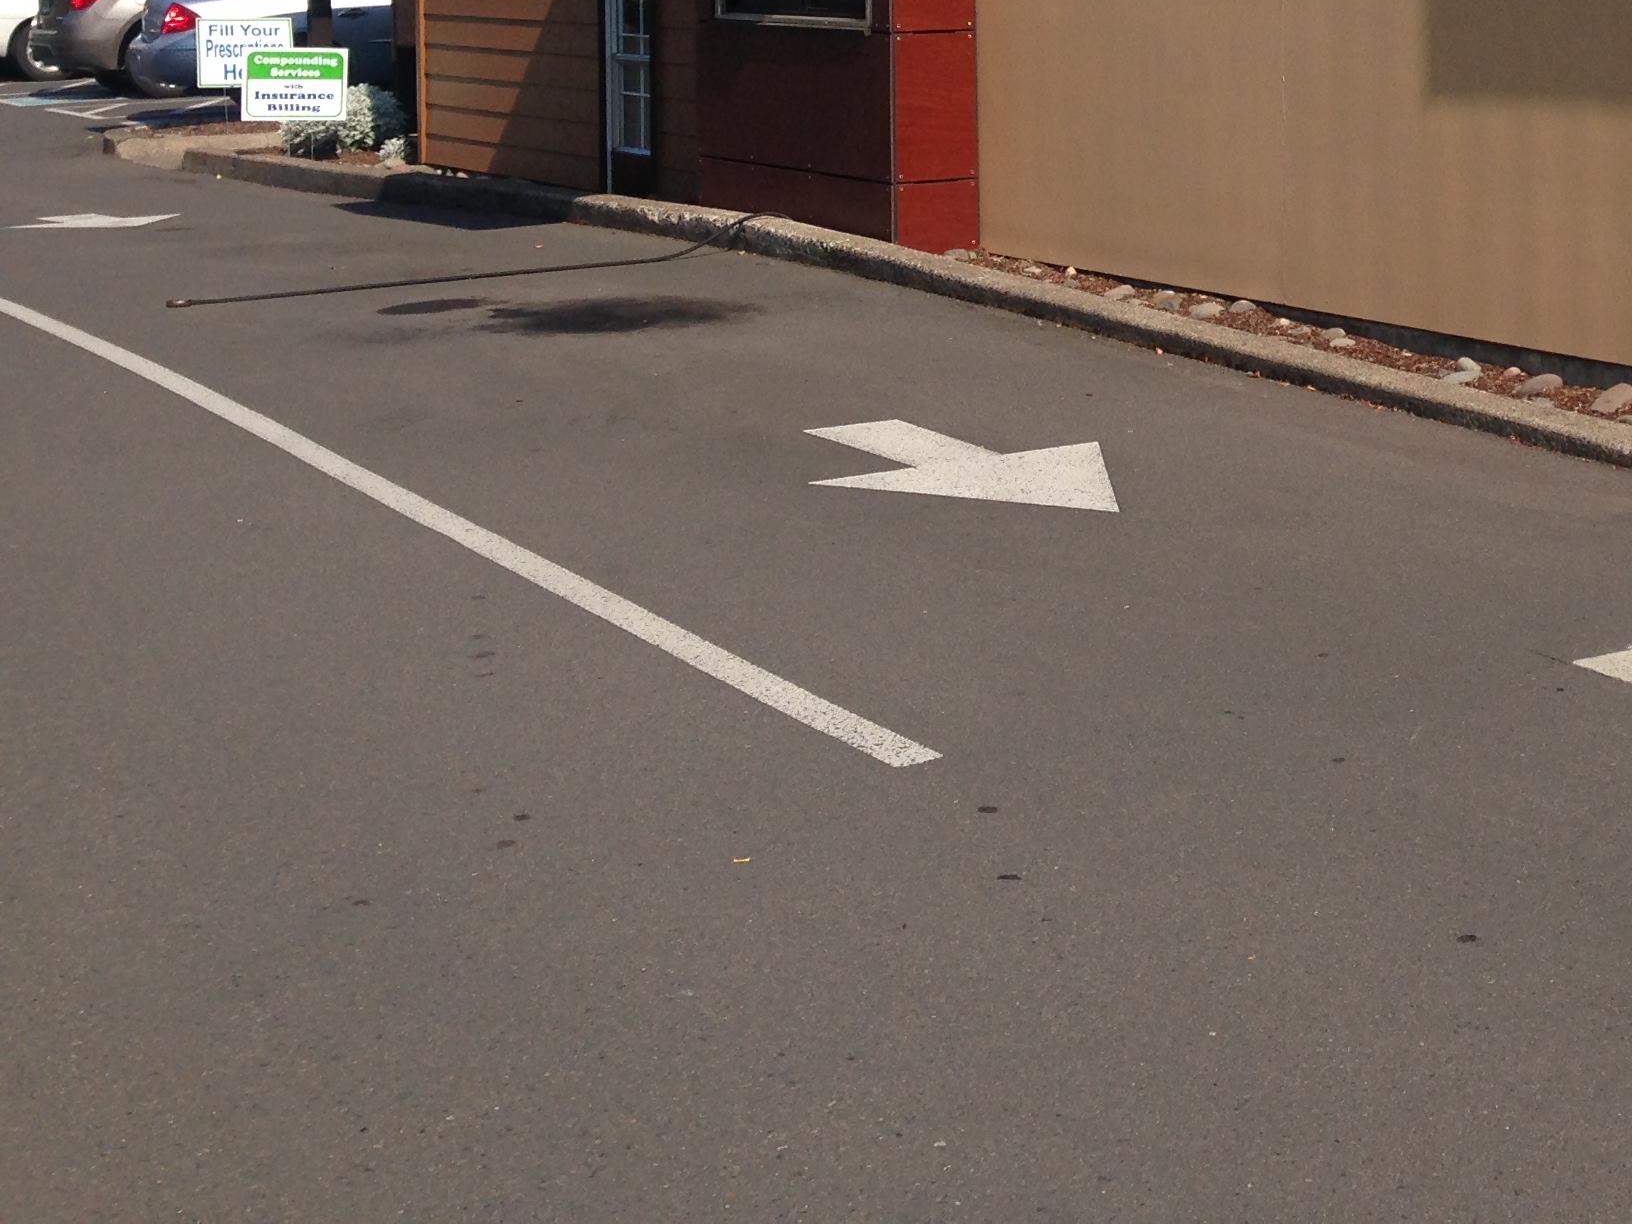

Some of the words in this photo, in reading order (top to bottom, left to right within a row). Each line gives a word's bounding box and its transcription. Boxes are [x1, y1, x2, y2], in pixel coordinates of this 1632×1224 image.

[208, 24, 234, 37] Fill
[240, 24, 281, 37] Your
[253, 55, 338, 67] Compounding
[270, 67, 320, 77] Services
[254, 91, 335, 100] Insurance
[267, 103, 321, 113] Billing
